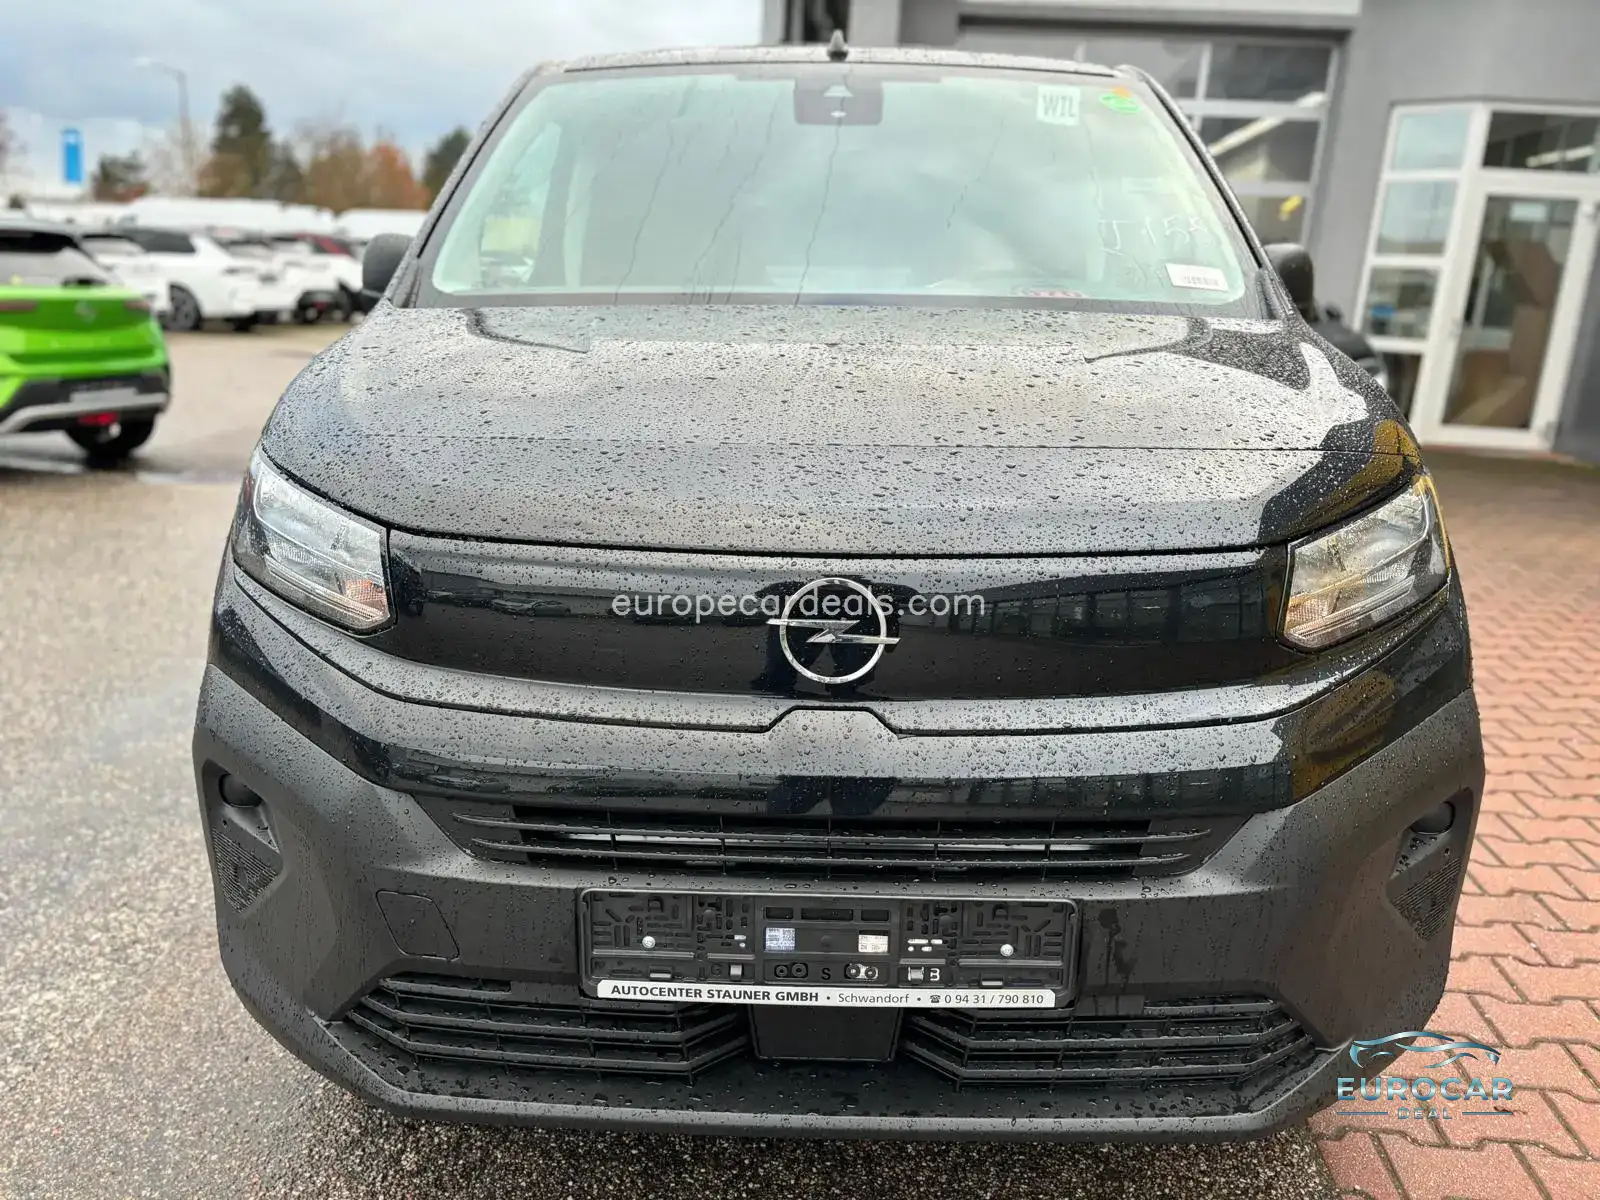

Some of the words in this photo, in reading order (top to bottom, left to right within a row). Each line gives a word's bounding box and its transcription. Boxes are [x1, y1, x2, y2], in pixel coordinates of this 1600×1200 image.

[610, 984, 703, 999] AUTOCENTER
[706, 989, 771, 1001] STAUNER
[775, 991, 819, 1002] GMBH
[838, 992, 910, 1004] Schwandorf
